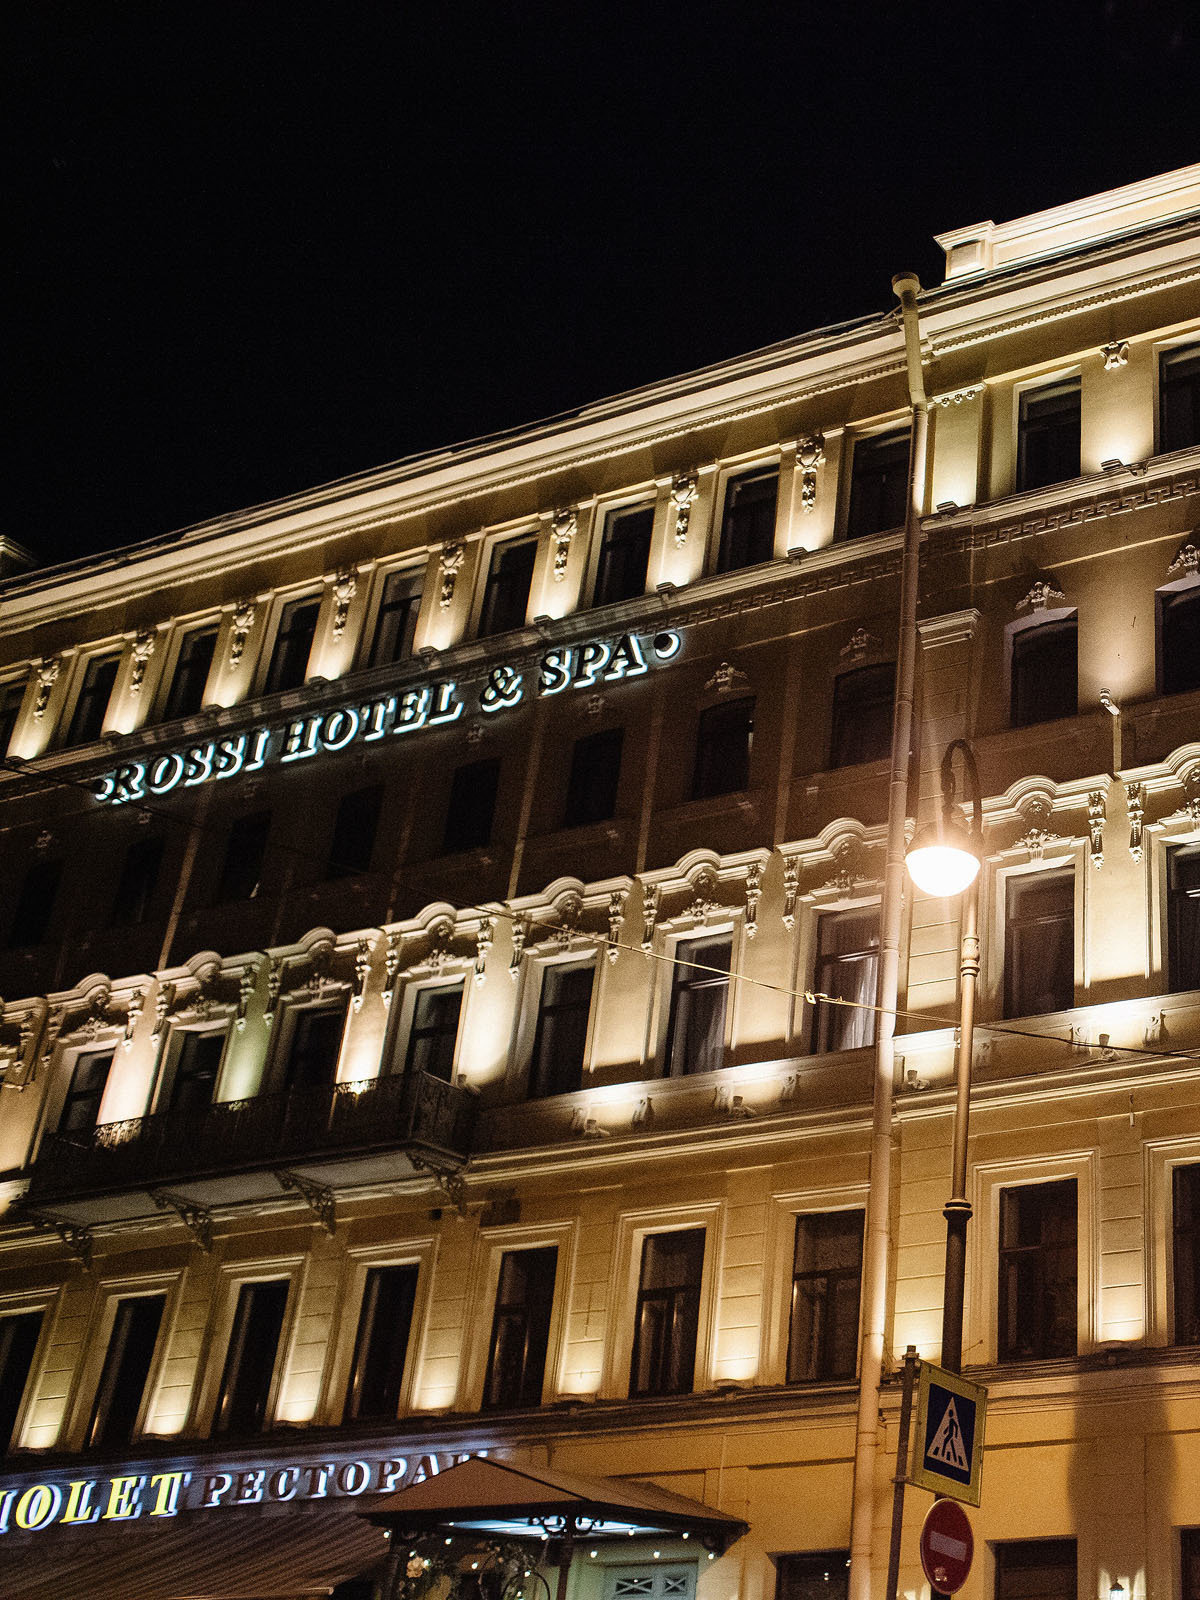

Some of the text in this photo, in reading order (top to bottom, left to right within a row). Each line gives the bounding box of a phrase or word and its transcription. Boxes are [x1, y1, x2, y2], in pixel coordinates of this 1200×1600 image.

[107, 633, 648, 804] ROSSI HOTEL & SPA
[200, 1450, 488, 1507] РЕСТОРА
